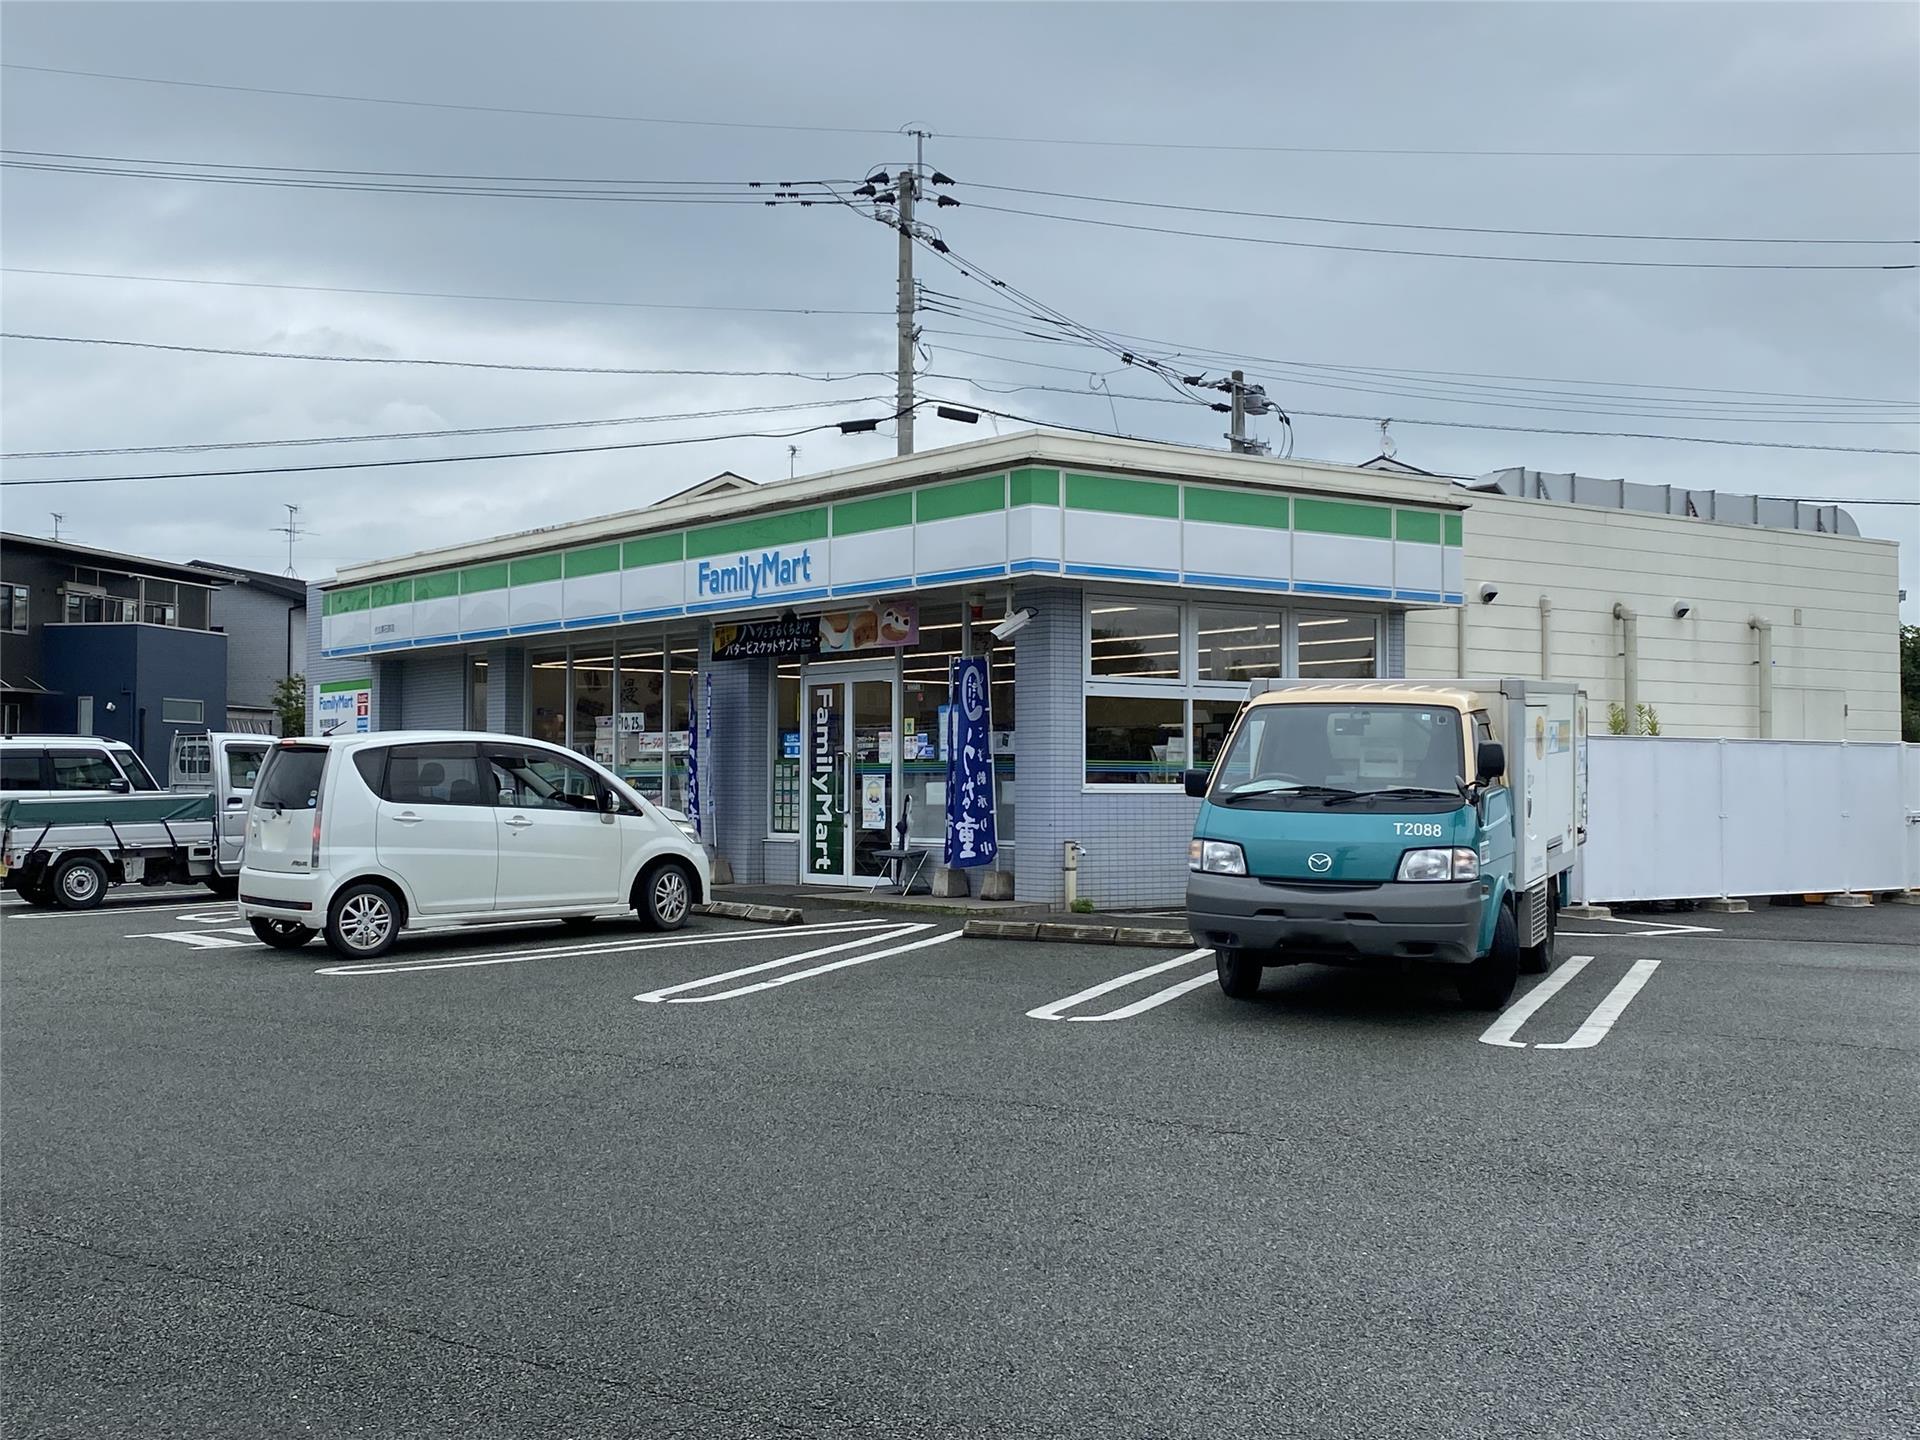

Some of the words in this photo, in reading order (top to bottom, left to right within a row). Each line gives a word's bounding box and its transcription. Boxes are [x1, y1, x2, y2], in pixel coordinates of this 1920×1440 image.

[698, 548, 811, 599] FamilyMart
[319, 695, 353, 713] FamilyMart
[811, 688, 834, 870] FamilyMart
[1393, 822, 1442, 838] T2088
